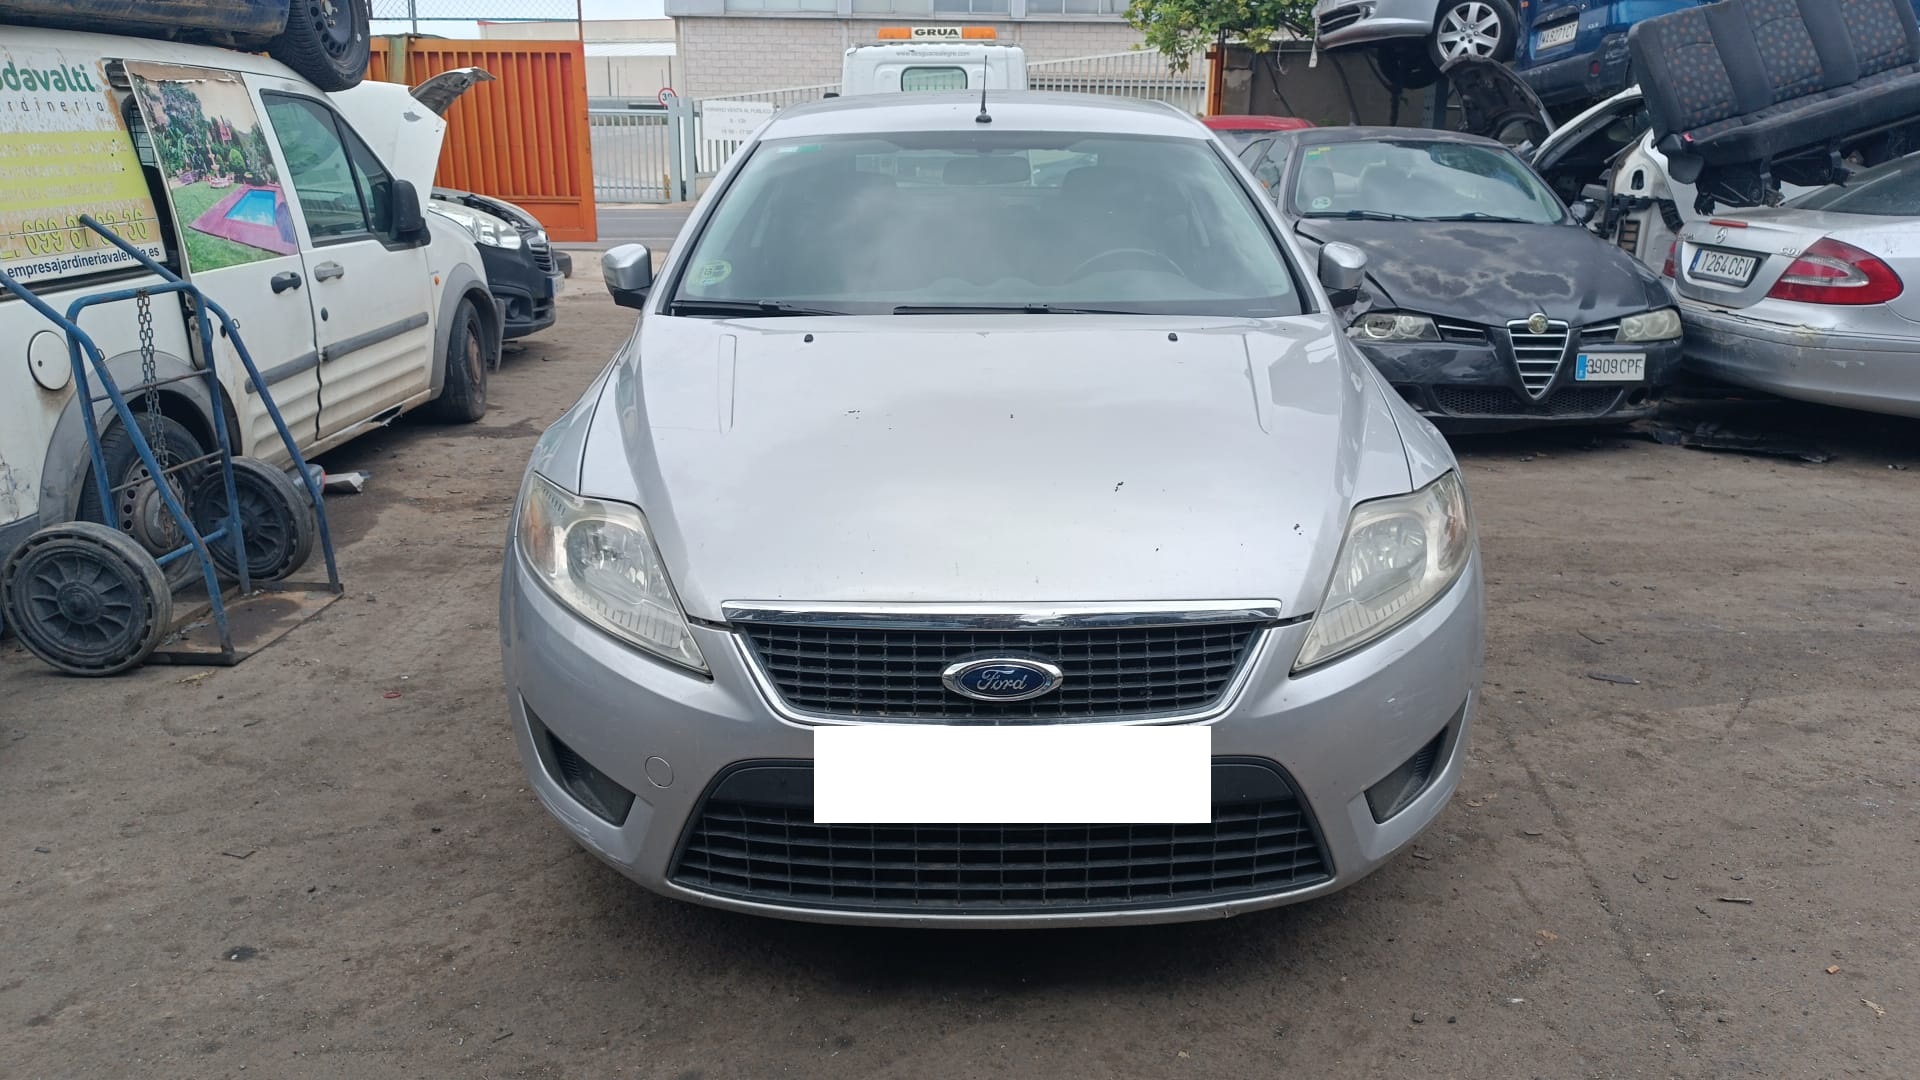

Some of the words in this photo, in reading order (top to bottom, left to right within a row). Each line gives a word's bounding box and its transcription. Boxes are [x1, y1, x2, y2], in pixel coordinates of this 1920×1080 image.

[914, 28, 959, 36] GRUA
[0, 60, 96, 92] davalti
[23, 219, 64, 255] 699
[123, 208, 147, 240] 36
[977, 669, 1028, 690] Ford
